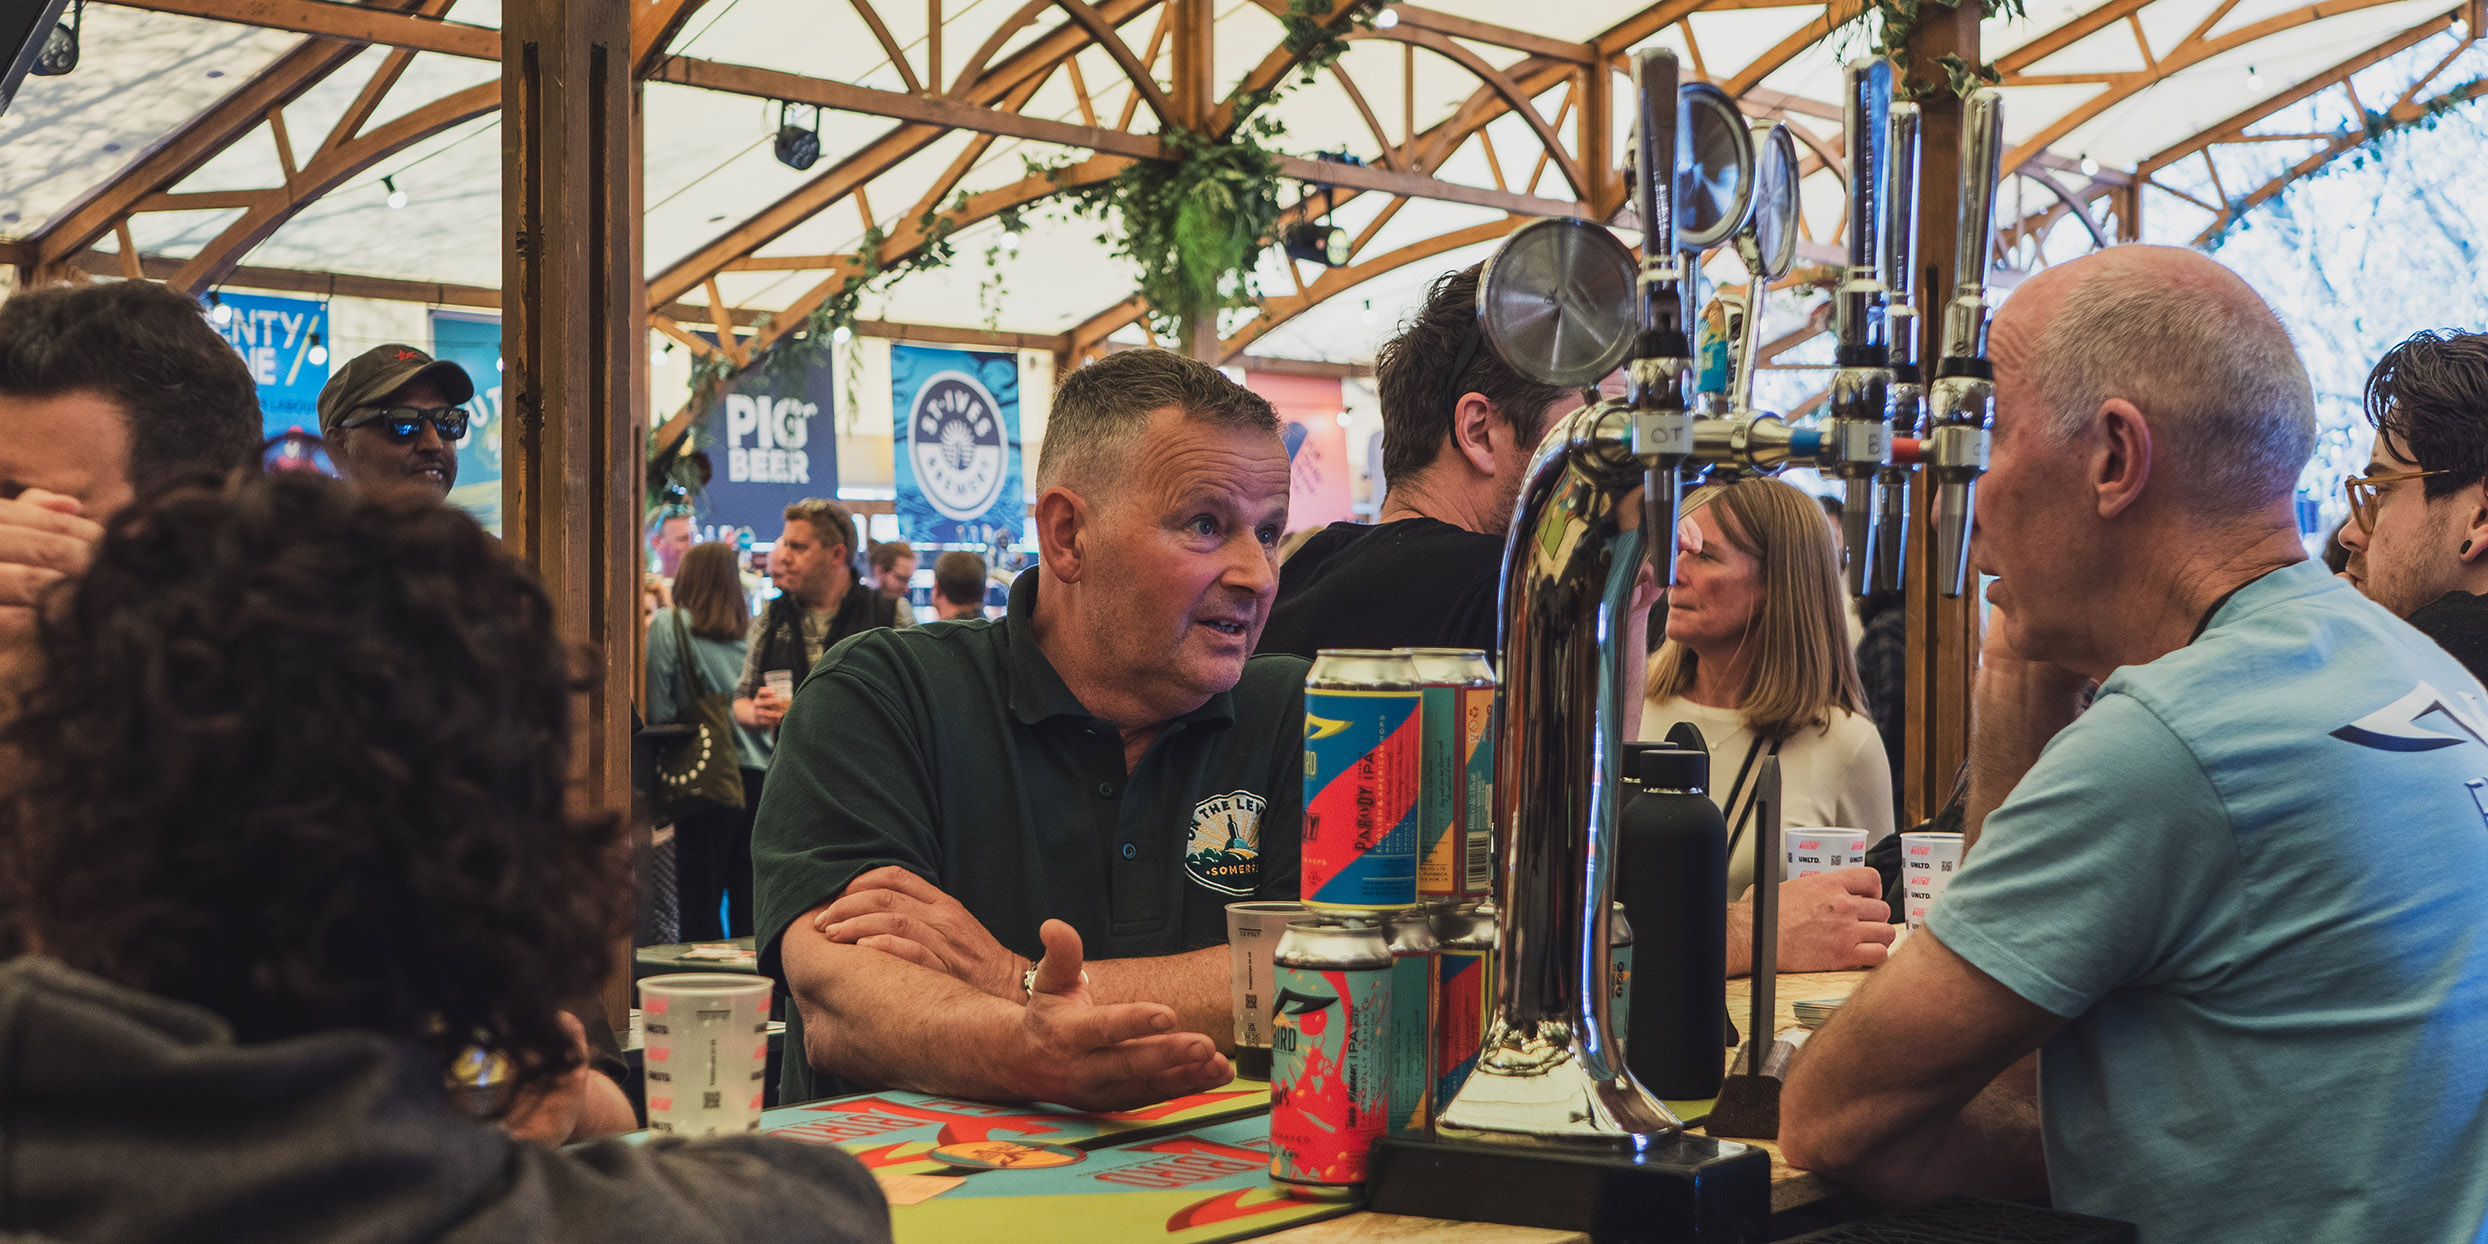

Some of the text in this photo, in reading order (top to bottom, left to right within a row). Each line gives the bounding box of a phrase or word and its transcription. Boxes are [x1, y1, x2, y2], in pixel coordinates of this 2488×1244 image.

[726, 393, 810, 449] PIG
[728, 447, 811, 484] BEER
[1187, 798, 1265, 841] ON THE LEV
[1353, 752, 1376, 852] PARODY IPA
[1376, 809, 1384, 853] ENGLISH
[1210, 863, 1259, 876] SOMERS
[1798, 856, 1820, 864] UNLTD.
[1348, 1030, 1358, 1059] IPA
